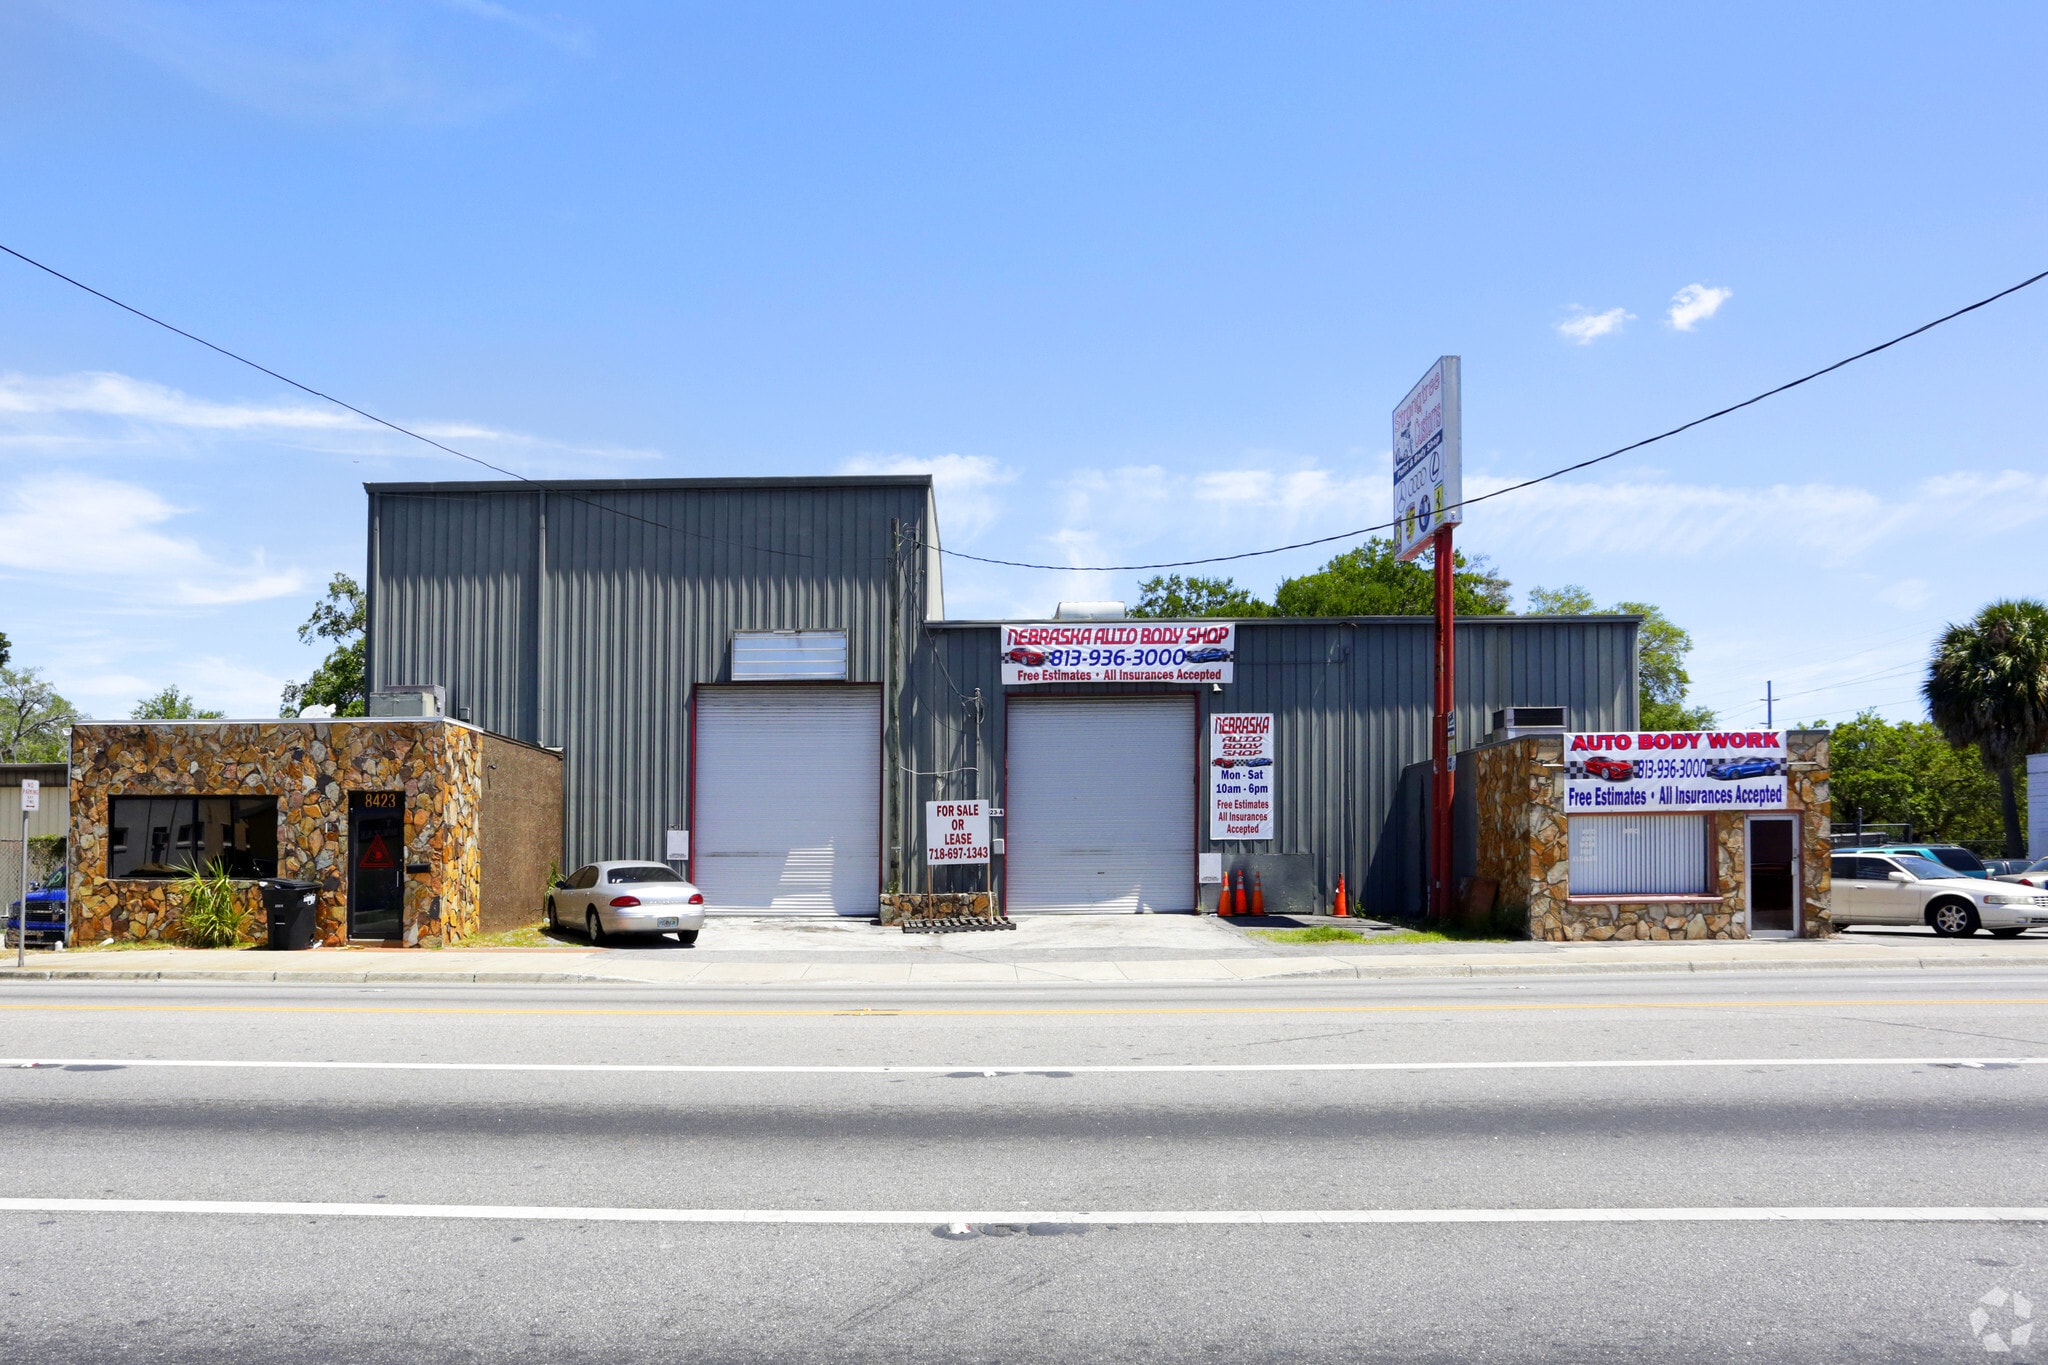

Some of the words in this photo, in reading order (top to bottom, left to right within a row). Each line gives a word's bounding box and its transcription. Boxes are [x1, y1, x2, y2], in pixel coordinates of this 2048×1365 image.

[1007, 629, 1092, 645] NEBRASKA
[1094, 628, 1138, 644] AUTO
[1140, 628, 1184, 644] BODY
[1186, 627, 1229, 644] SHOP
[1050, 649, 1187, 666] 813-936-3000
[1017, 670, 1039, 681] Free
[1042, 669, 1092, 681] Estimates
[1104, 669, 1117, 680] All
[1119, 668, 1174, 680] Insurances
[1176, 668, 1222, 682] Accepted
[1215, 717, 1270, 734] NEBRASKA
[1571, 735, 1631, 751] AUTO
[1638, 734, 1701, 750] BODY
[1707, 732, 1780, 749] WORK
[1221, 770, 1240, 780] Mon
[1248, 770, 1263, 779] Sat
[1638, 759, 1707, 778] 813-936-3000
[1216, 784, 1241, 793] 10am
[1249, 784, 1268, 795] 6pm
[1569, 788, 1592, 806] Free
[1595, 787, 1646, 805] Estimates
[1659, 786, 1673, 804] All
[1676, 786, 1733, 804] Insurances
[1735, 784, 1782, 807] Accepted
[365, 793, 396, 808] 8423
[1217, 800, 1232, 809] Free
[1234, 800, 1269, 809] Estimates
[937, 805, 954, 817] FOR
[957, 804, 978, 816] SALE
[1218, 812, 1227, 821] All
[1229, 812, 1267, 821] Insurances
[952, 819, 964, 831] OR
[1227, 824, 1259, 835] Accepted
[945, 833, 972, 845] LEASE
[929, 847, 988, 860] 718-697-1343
